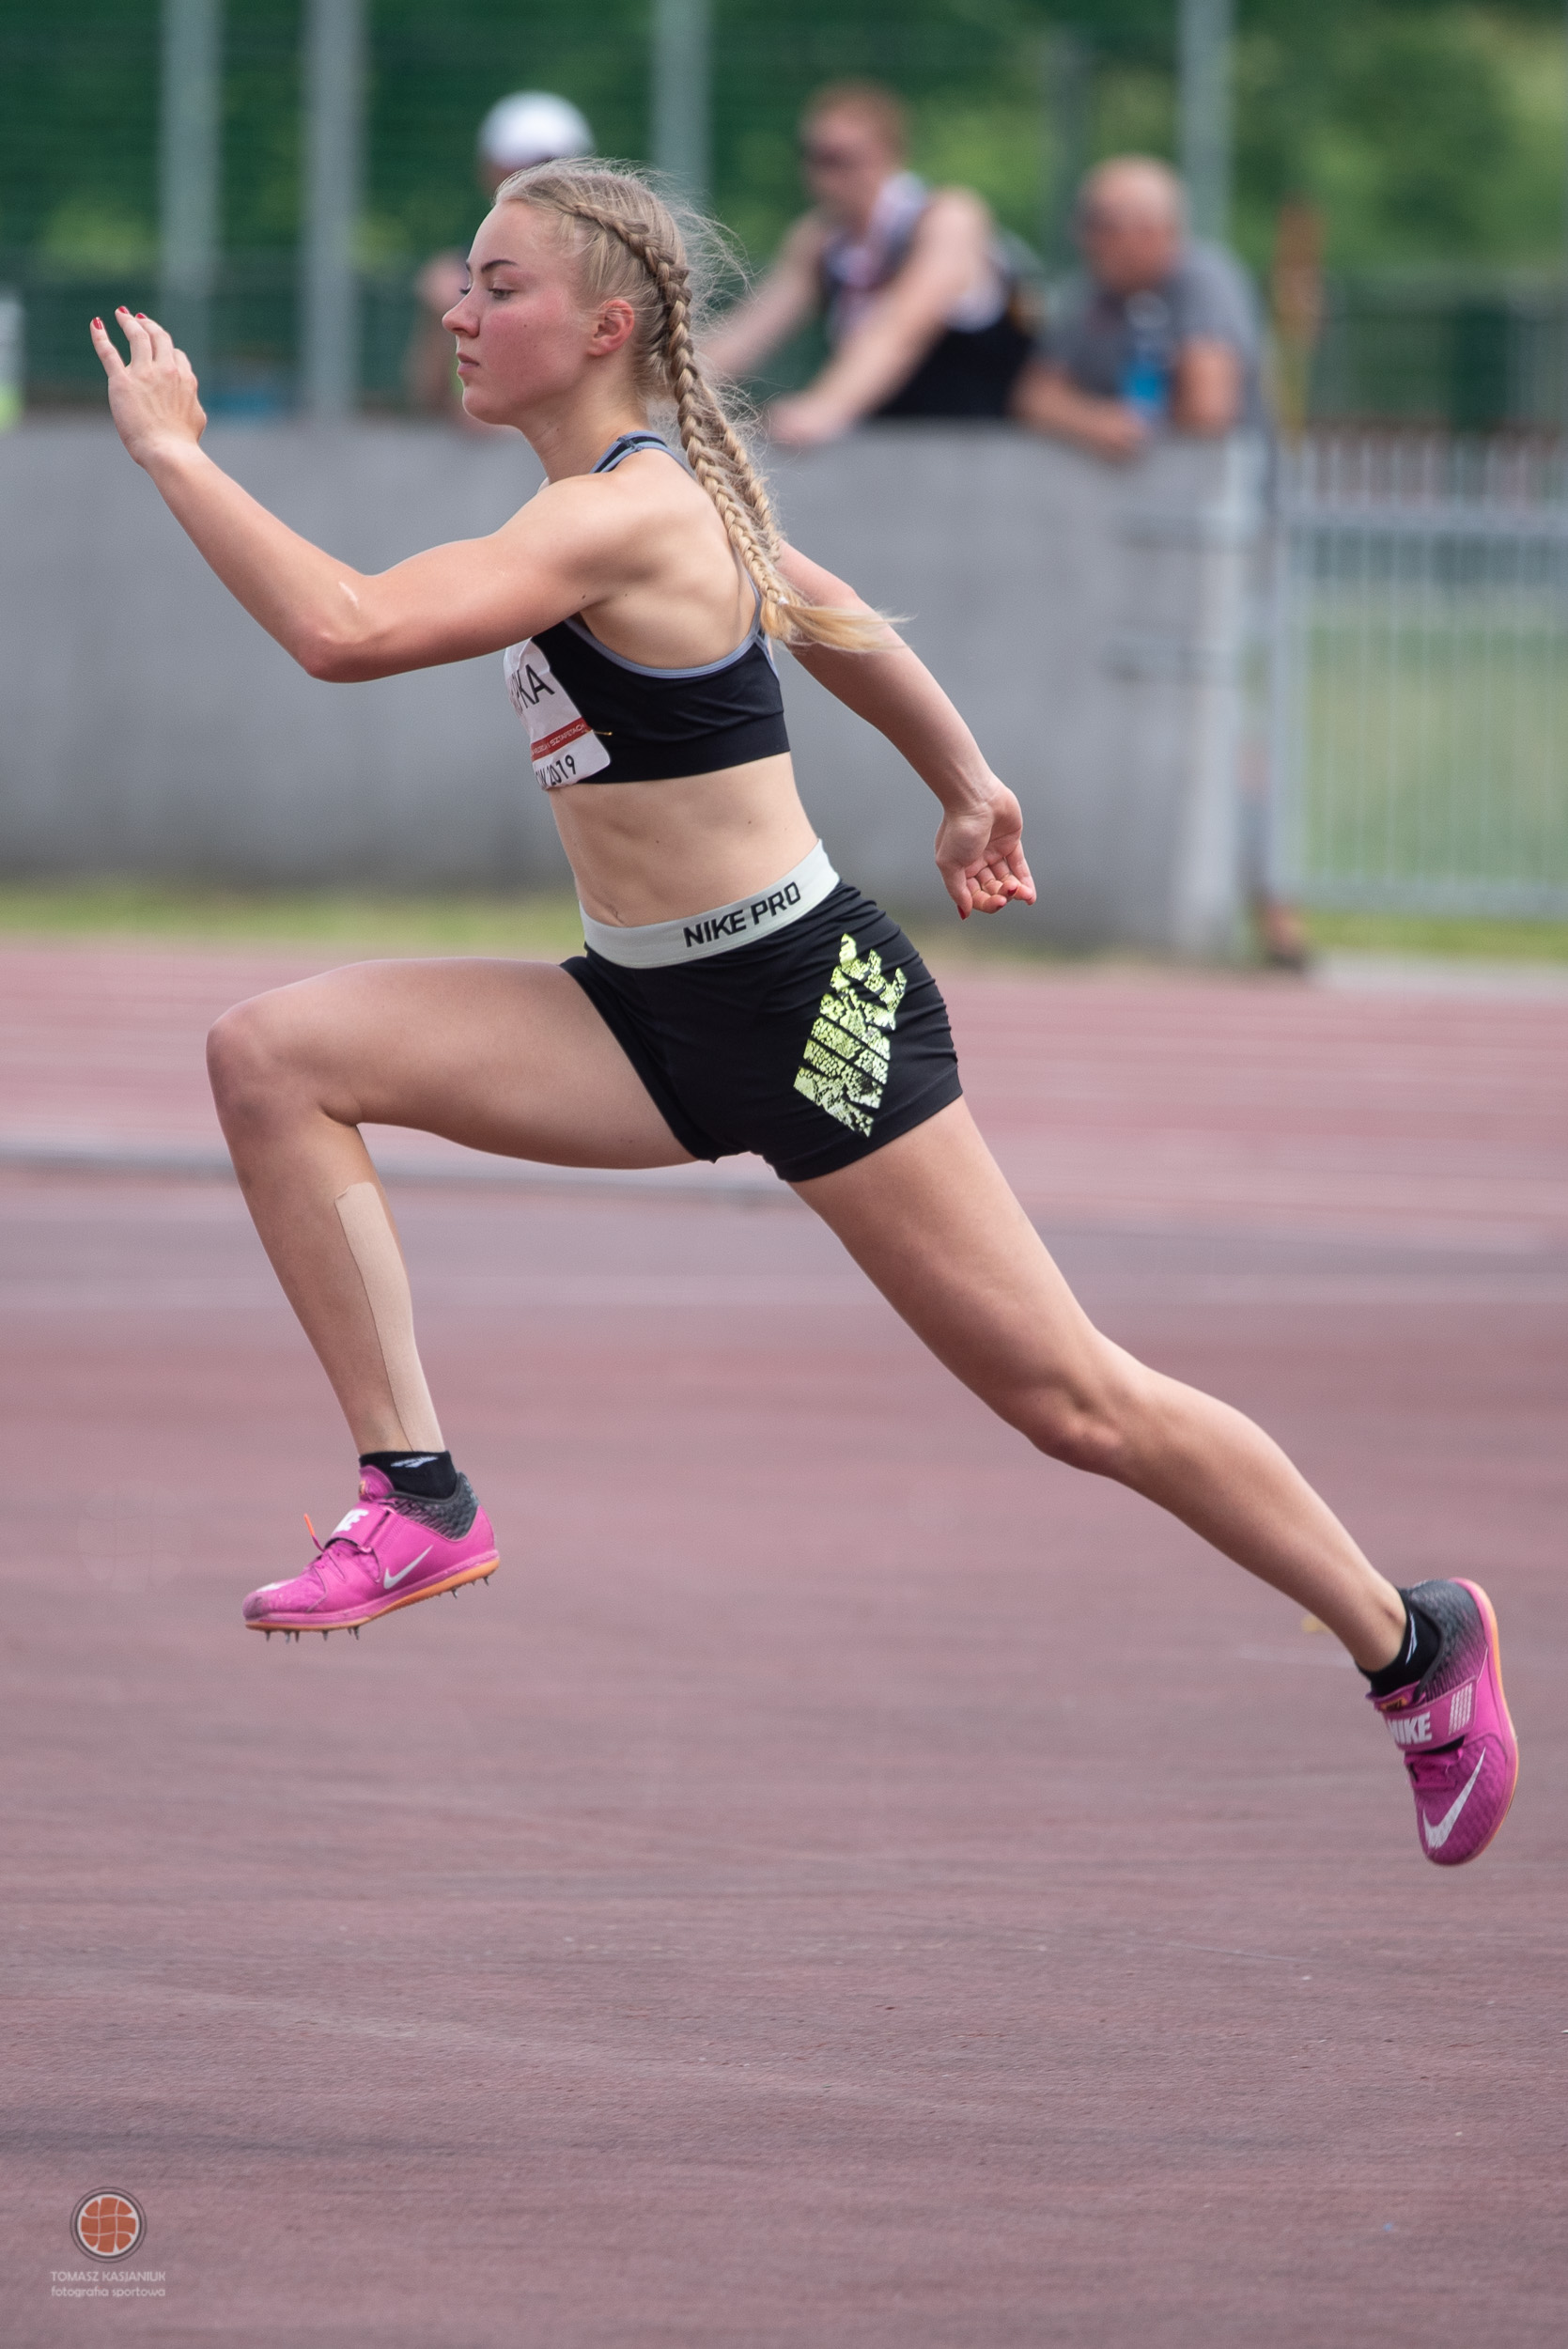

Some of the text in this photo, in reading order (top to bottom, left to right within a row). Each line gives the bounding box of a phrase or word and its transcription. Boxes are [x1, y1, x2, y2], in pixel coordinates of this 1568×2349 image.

[546, 754, 576, 786] 2019
[683, 881, 801, 948] NIKE PRO
[793, 933, 908, 1138] NIKE
